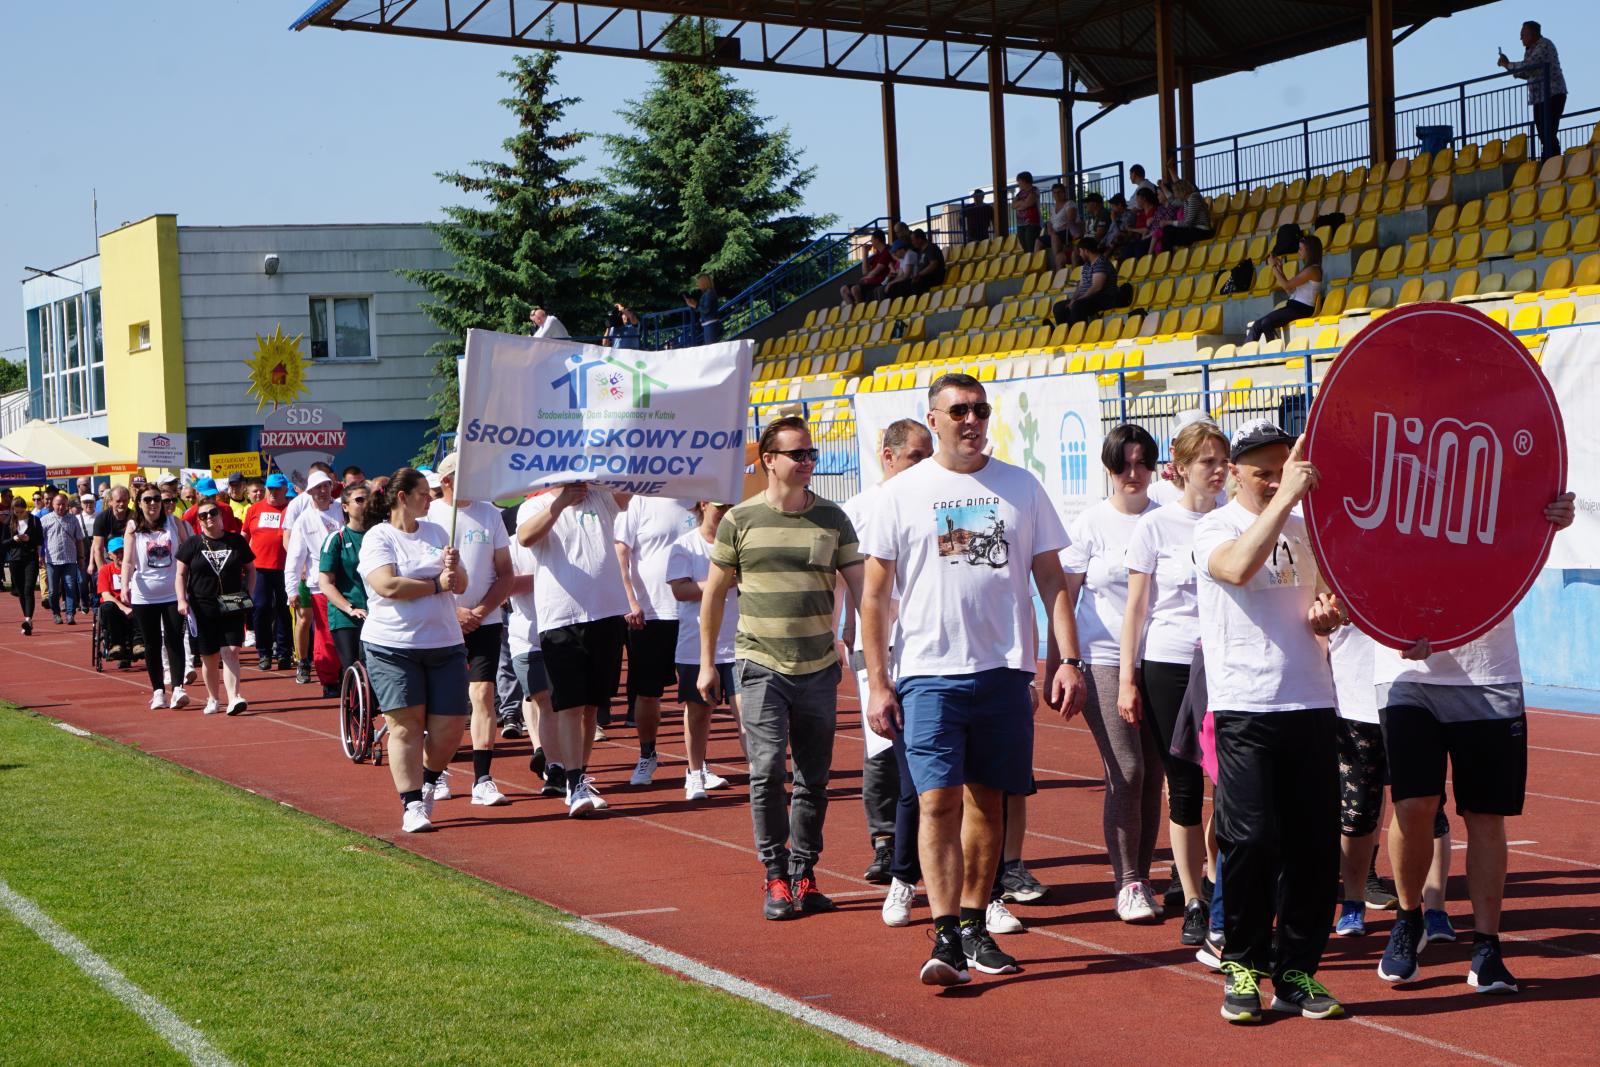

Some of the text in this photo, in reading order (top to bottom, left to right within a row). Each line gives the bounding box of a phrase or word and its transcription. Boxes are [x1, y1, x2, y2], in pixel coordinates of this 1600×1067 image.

[286, 404, 323, 425] ŚDS
[537, 408, 584, 421] Środowiskowy
[586, 410, 602, 419] Dom
[603, 410, 647, 422] Samopomocy
[655, 410, 676, 420] Kutnie
[260, 431, 346, 447] DRZEWOCINY
[465, 419, 744, 450] ŚRODOWISKOWY DOM
[508, 452, 704, 476] SAMOPOMOCY
